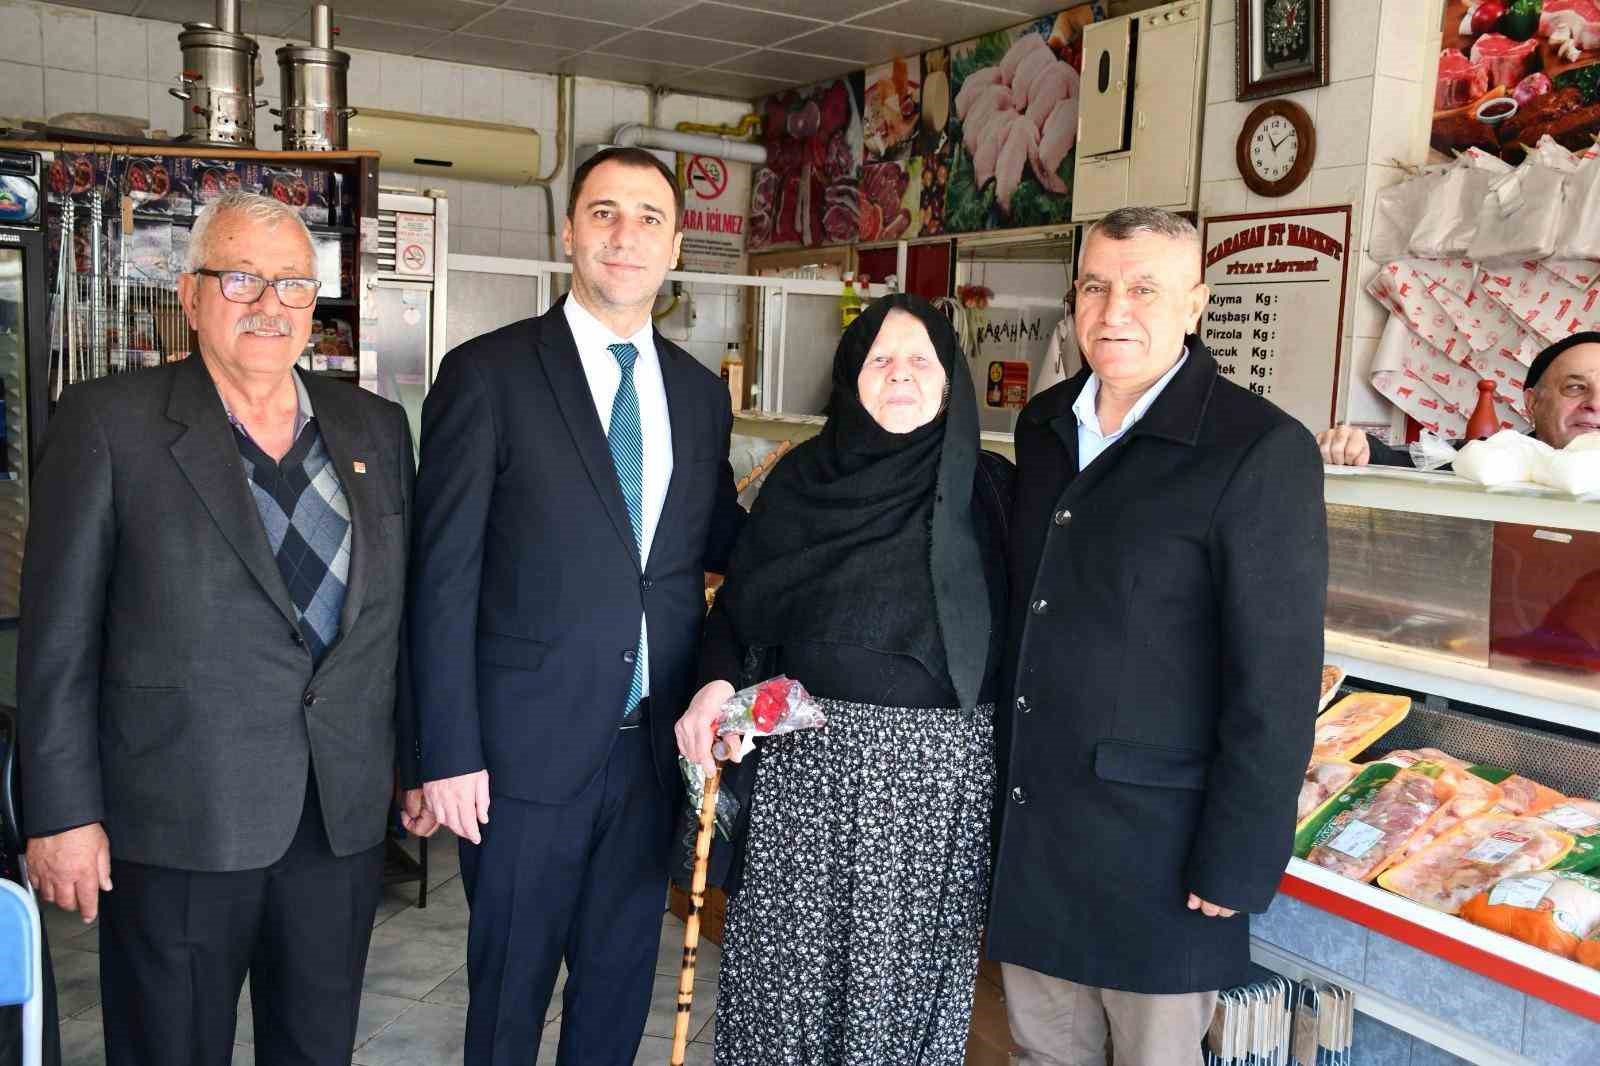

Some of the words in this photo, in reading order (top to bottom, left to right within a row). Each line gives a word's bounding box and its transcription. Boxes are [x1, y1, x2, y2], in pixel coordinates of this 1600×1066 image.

[1205, 225, 1266, 268] KARAHAN
[1267, 223, 1286, 246] ET
[1287, 224, 1343, 261] MARKET
[1226, 261, 1263, 275] FİYAT
[1208, 294, 1242, 307] Kıyma
[1207, 311, 1250, 324] Kuşbaşı
[1206, 328, 1242, 340] Pirzola
